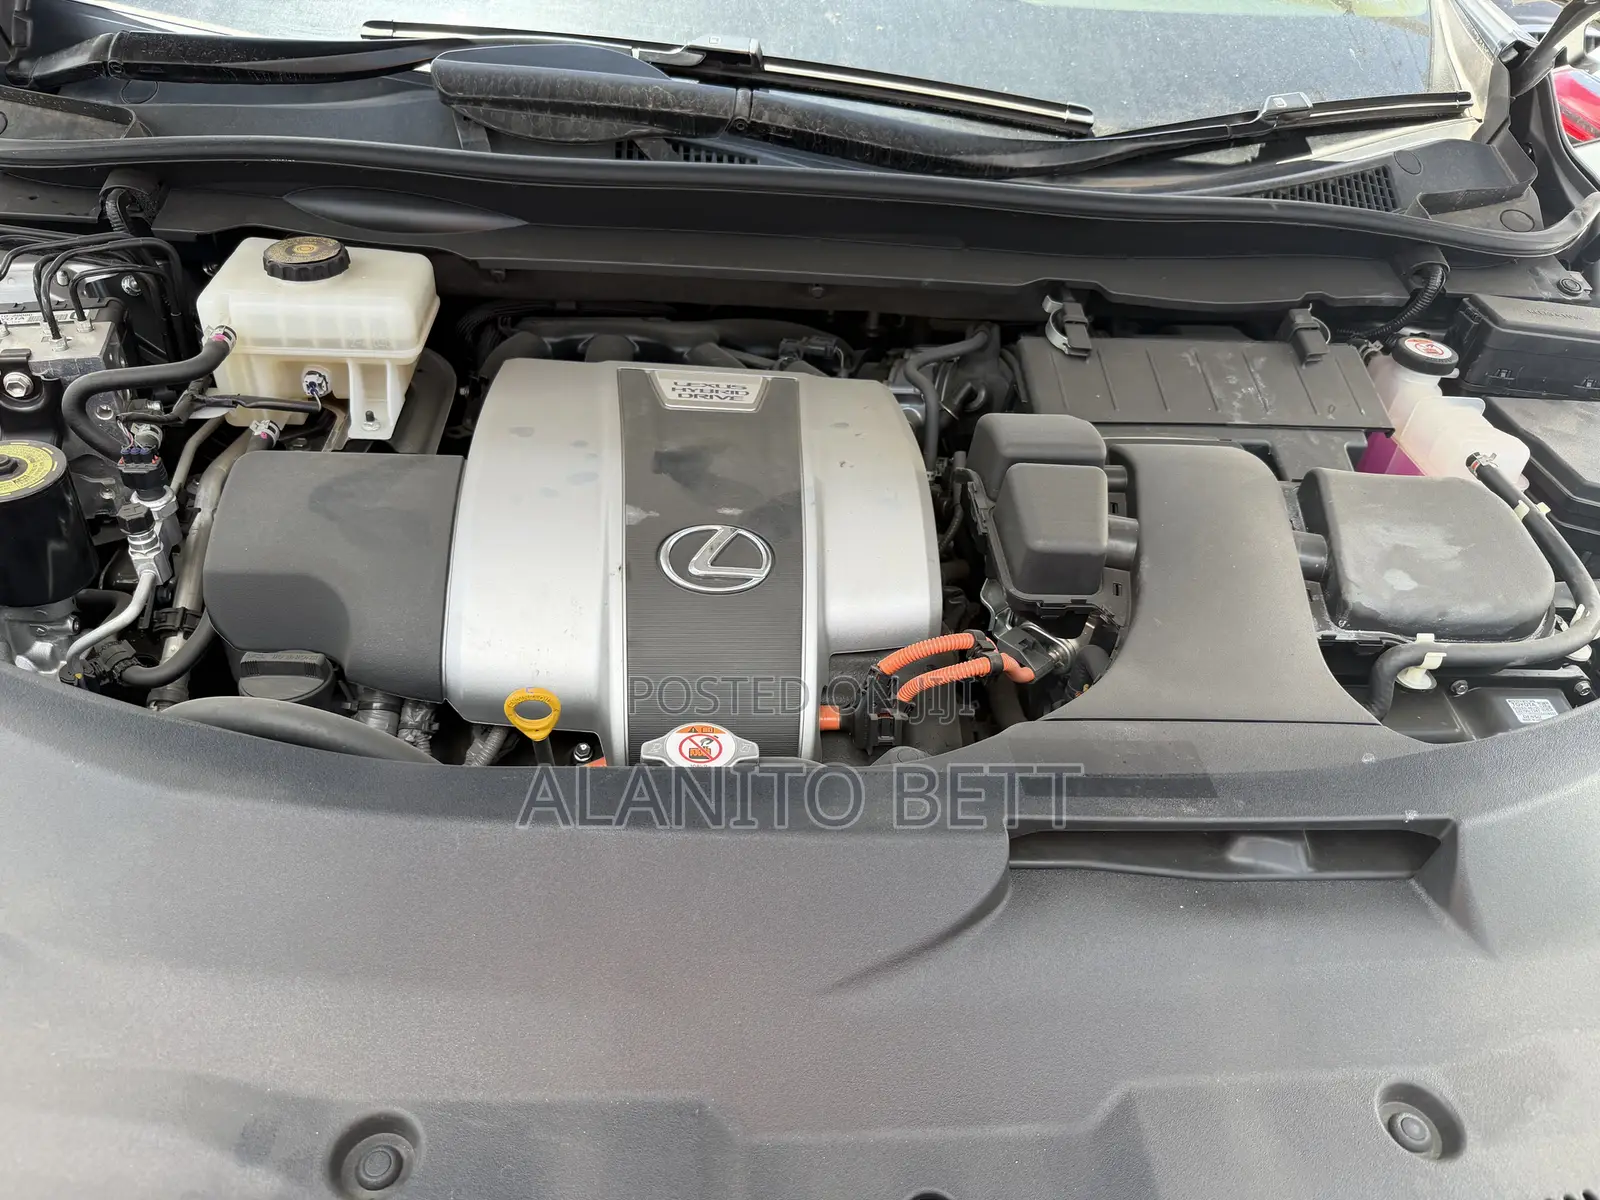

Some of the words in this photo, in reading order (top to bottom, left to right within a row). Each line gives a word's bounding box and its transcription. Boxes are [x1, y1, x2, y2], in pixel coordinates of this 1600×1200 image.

[673, 381, 747, 390] LEXUS
[671, 387, 750, 396] HYBRID
[677, 393, 745, 401] DRIVE
